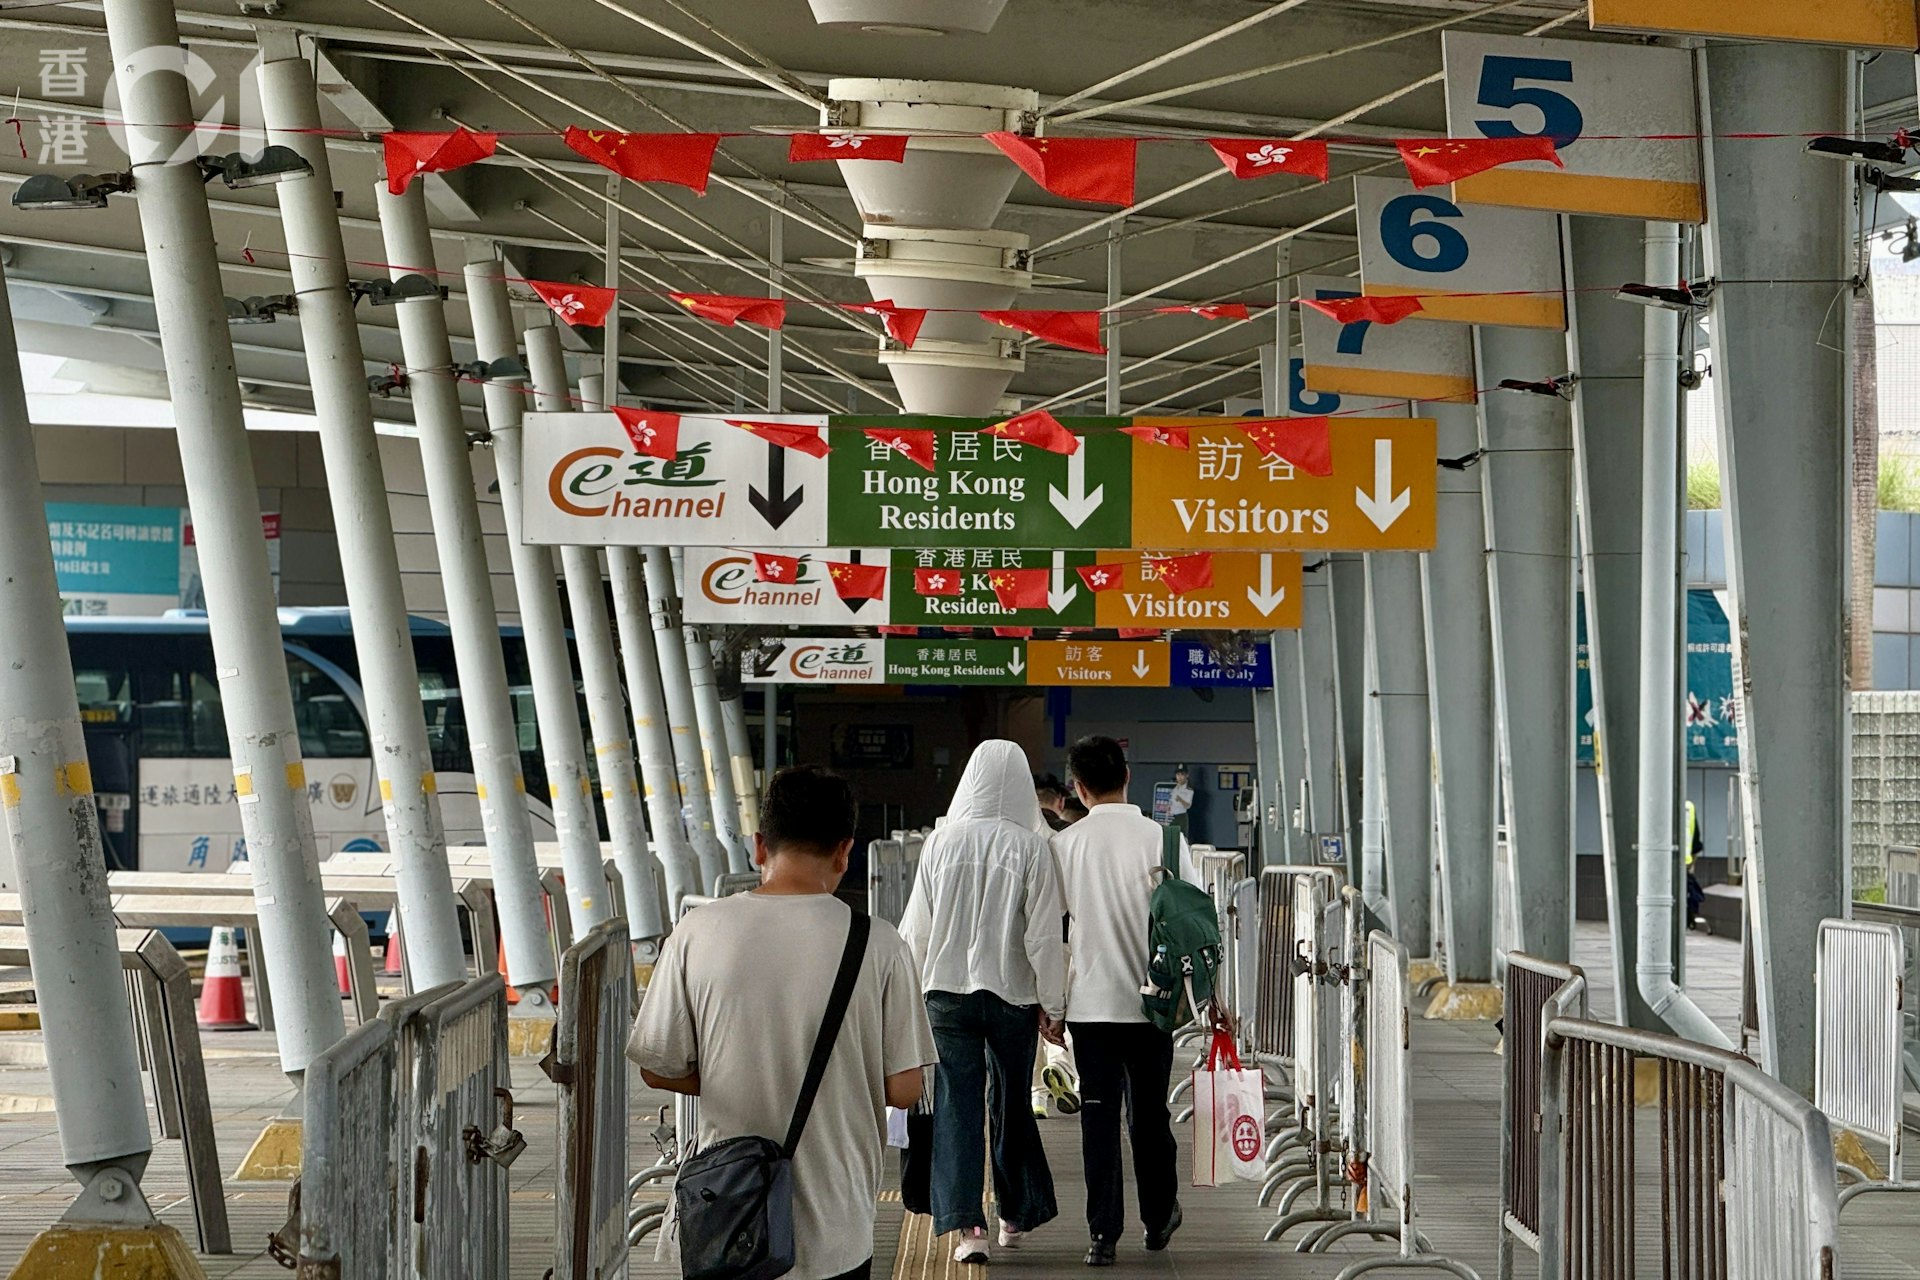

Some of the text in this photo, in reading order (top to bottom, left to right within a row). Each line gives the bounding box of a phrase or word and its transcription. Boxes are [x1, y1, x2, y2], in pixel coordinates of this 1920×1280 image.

[1474, 54, 1583, 149] 5
[1379, 193, 1469, 272] 6
[865, 431, 1023, 462] 香居民
[1197, 437, 1295, 482] 訪客
[548, 446, 726, 517] Channel
[862, 470, 1025, 502] Hong Kong
[879, 505, 1016, 530] Residents
[1171, 498, 1329, 535] Visitors
[915, 548, 1022, 568] 香港居民
[701, 557, 821, 605] Channel
[1123, 593, 1230, 618] Visitors
[789, 645, 873, 679] Channel
[917, 648, 977, 662] 香港居民
[1065, 645, 1104, 662] 訪客
[888, 663, 1005, 677] Hong Kong Residents
[1057, 666, 1112, 680] Visitors
[1191, 668, 1255, 682] Staff Only
